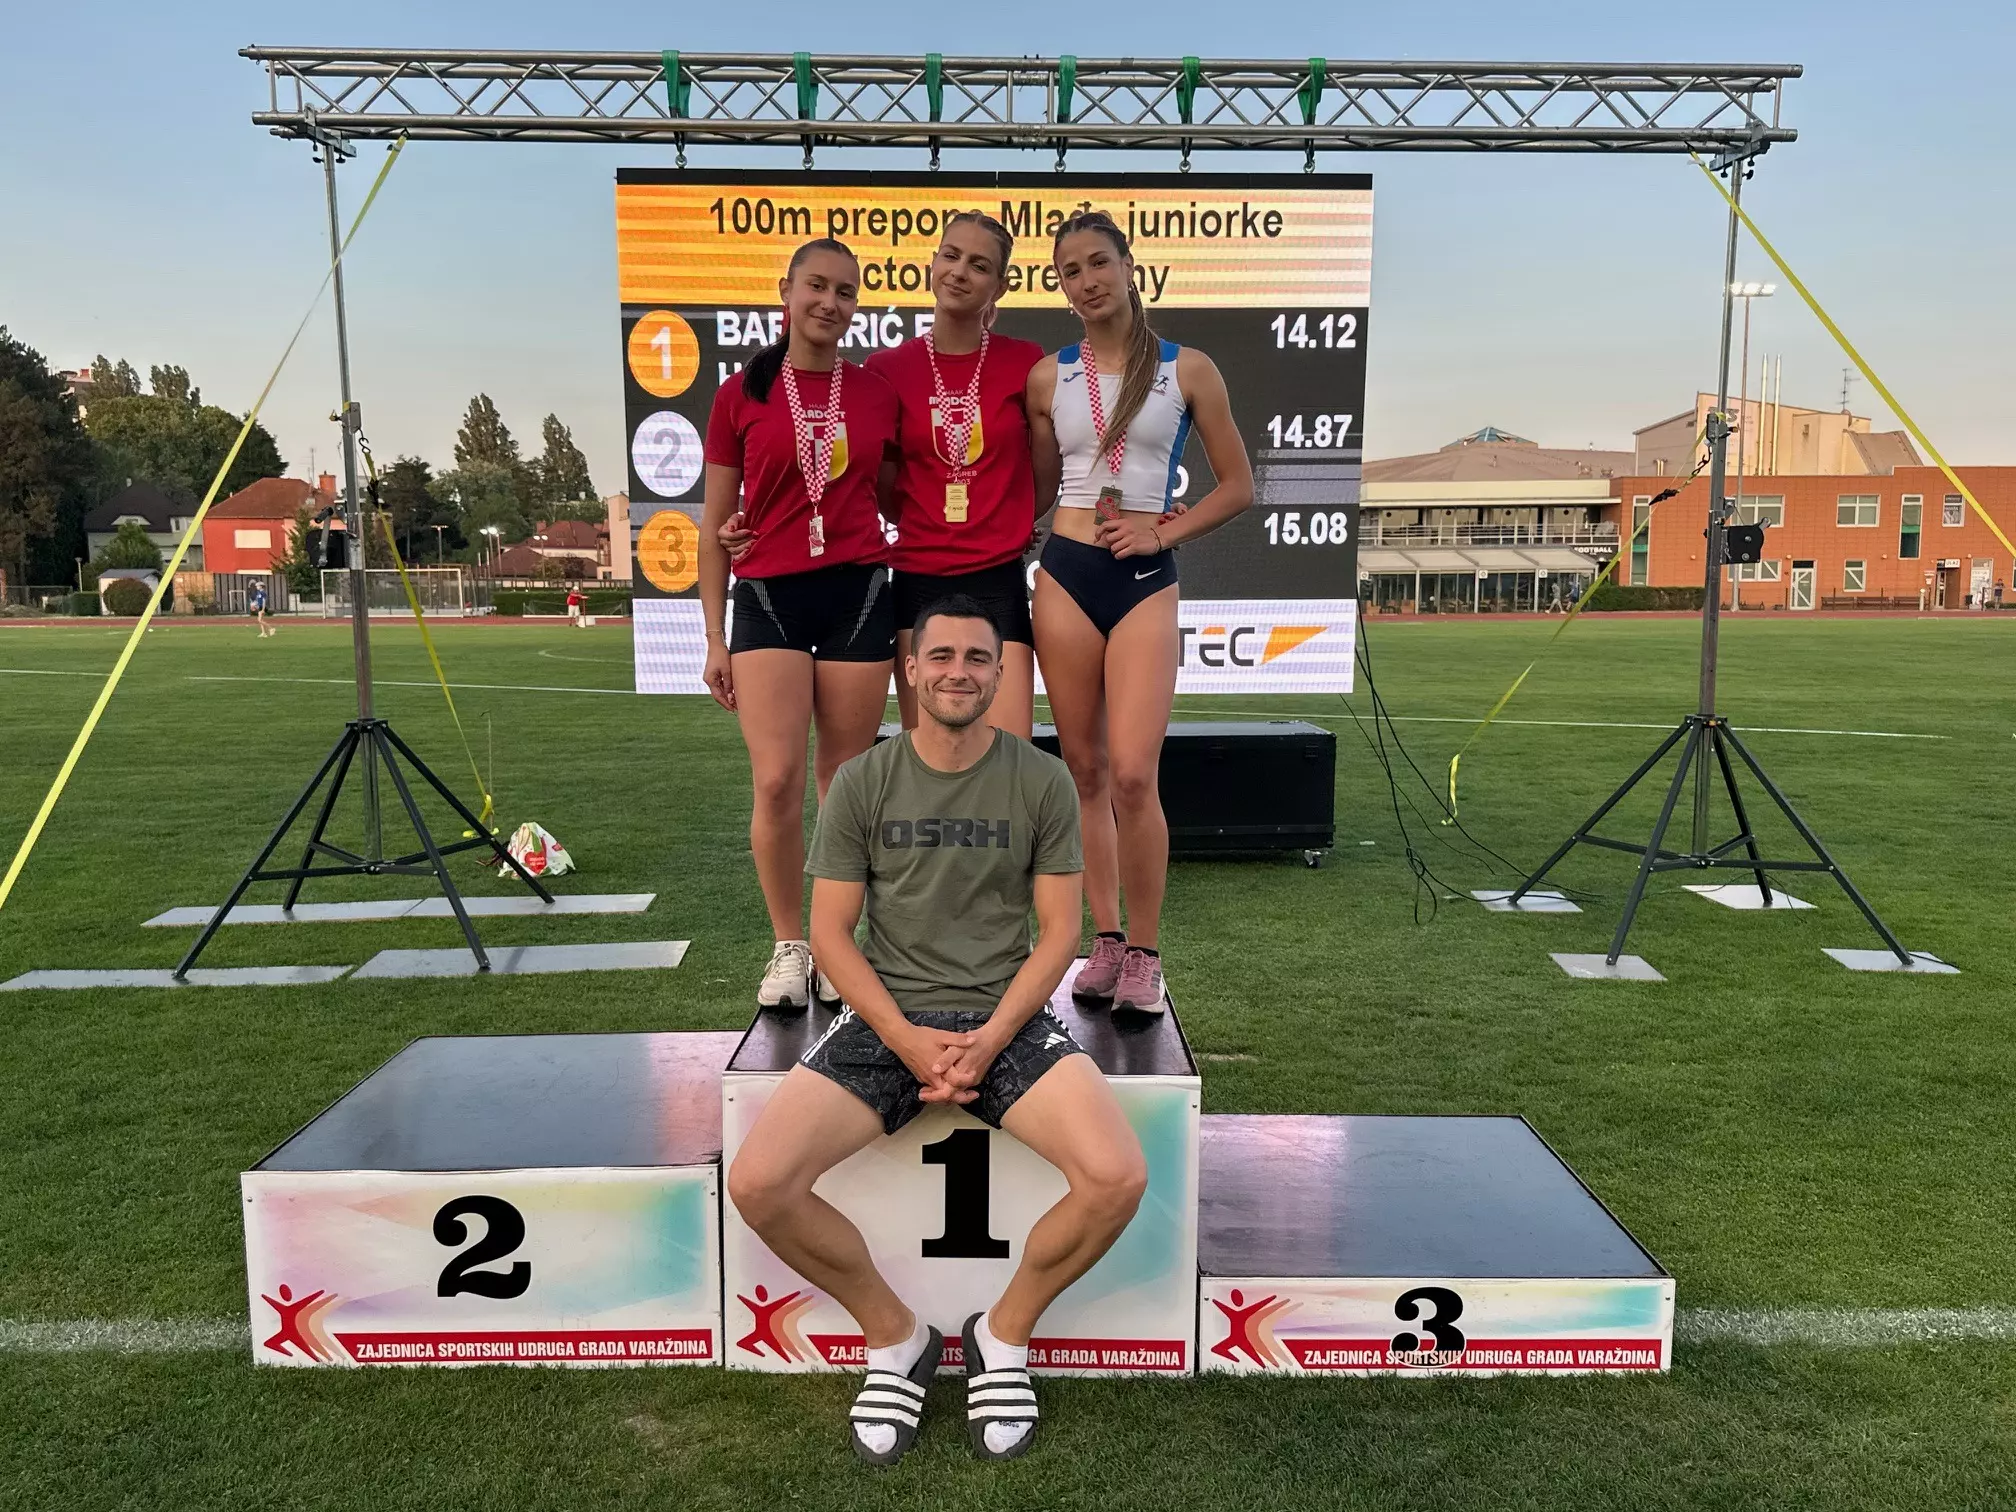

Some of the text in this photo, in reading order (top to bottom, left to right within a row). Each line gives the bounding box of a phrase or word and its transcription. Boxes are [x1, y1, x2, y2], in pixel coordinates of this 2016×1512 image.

[710, 197, 811, 235] 100m
[1000, 200, 1113, 237] Mla
[1127, 200, 1284, 247] juniorke
[1006, 264, 1171, 303] ereny
[651, 326, 672, 380] 1
[1271, 313, 1357, 349] 14.12
[653, 414, 1353, 479] 2 14.87
[658, 512, 1348, 576] 3 15.08
[881, 818, 1010, 849] OSRH
[921, 1128, 1010, 1258] 1
[433, 1195, 531, 1299] 2
[356, 1338, 708, 1358] ZAJEDNICA SPORTSKIH UDRUGA GRADA VARAŽDINA
[1391, 1287, 1465, 1367] 3
[1051, 1349, 1099, 1365] GRADA
[1101, 1347, 1180, 1366] VARAŽDINA
[1303, 1347, 1656, 1365] ZAJEDNICA SPORTSKIH UDRUGA GRADA VARAŽDINA
